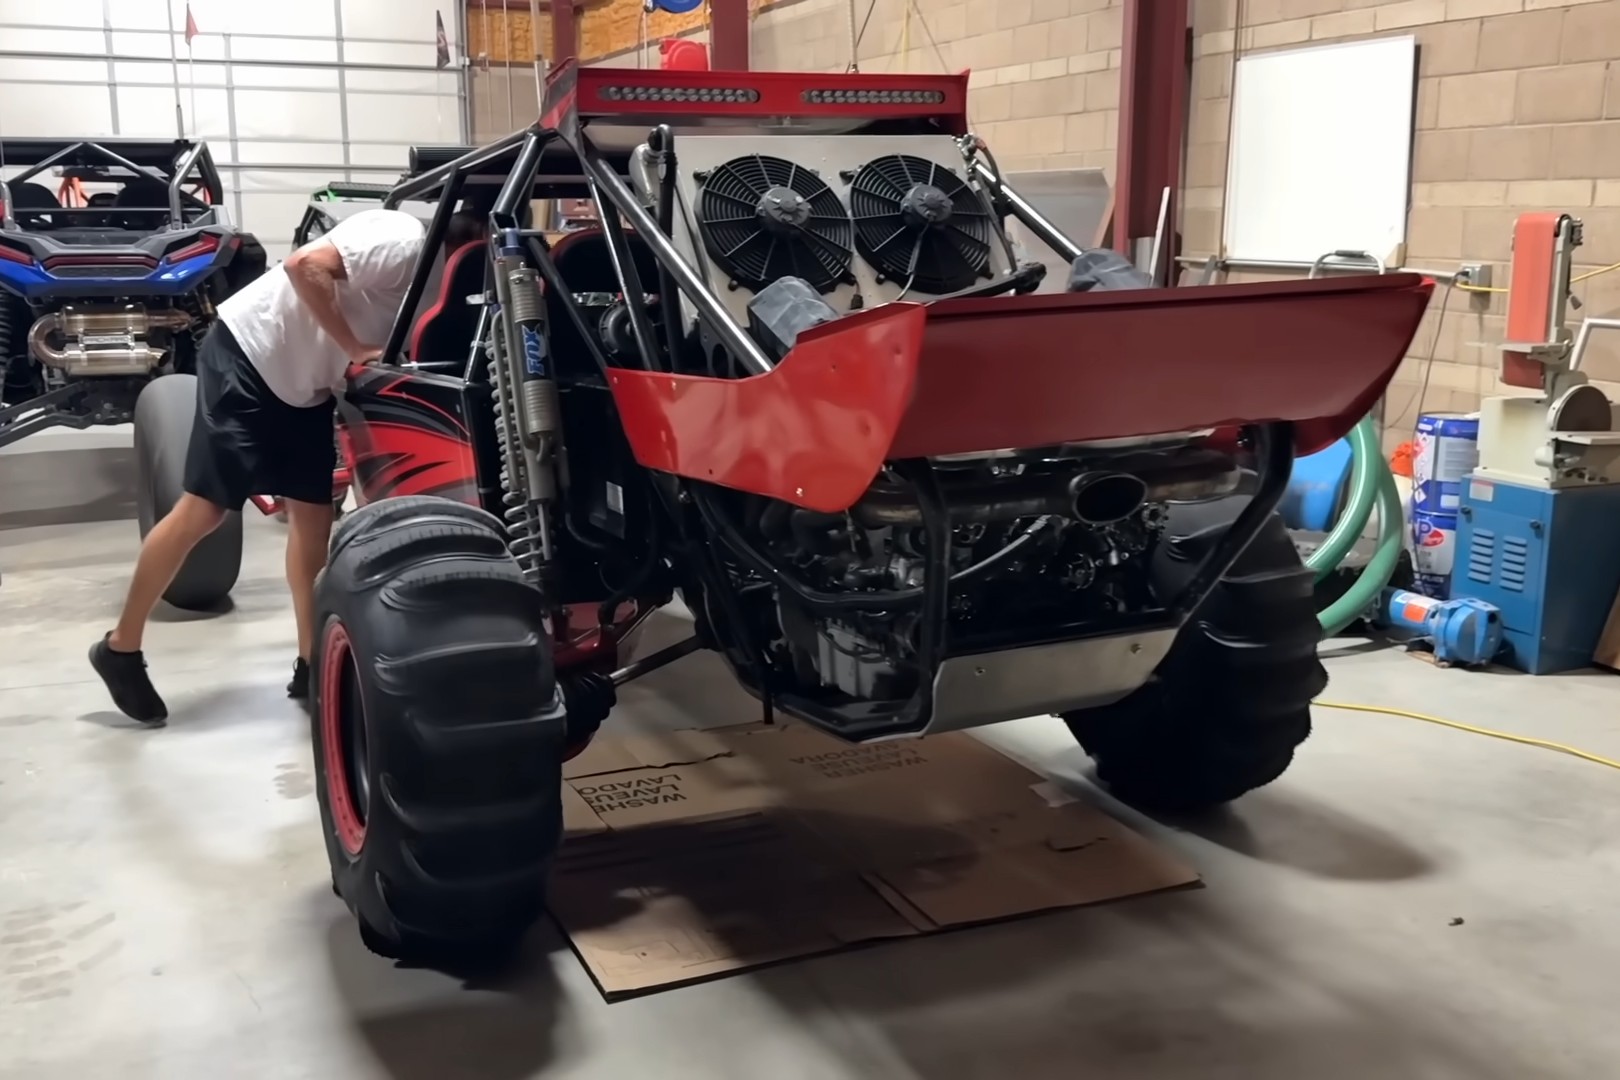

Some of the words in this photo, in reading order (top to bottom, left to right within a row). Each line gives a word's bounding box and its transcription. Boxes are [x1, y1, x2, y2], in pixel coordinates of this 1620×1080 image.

[521, 324, 545, 376] FOX
[823, 757, 928, 778] WASHER
[579, 774, 682, 795] LAVADO
[594, 793, 687, 813] WASHE
